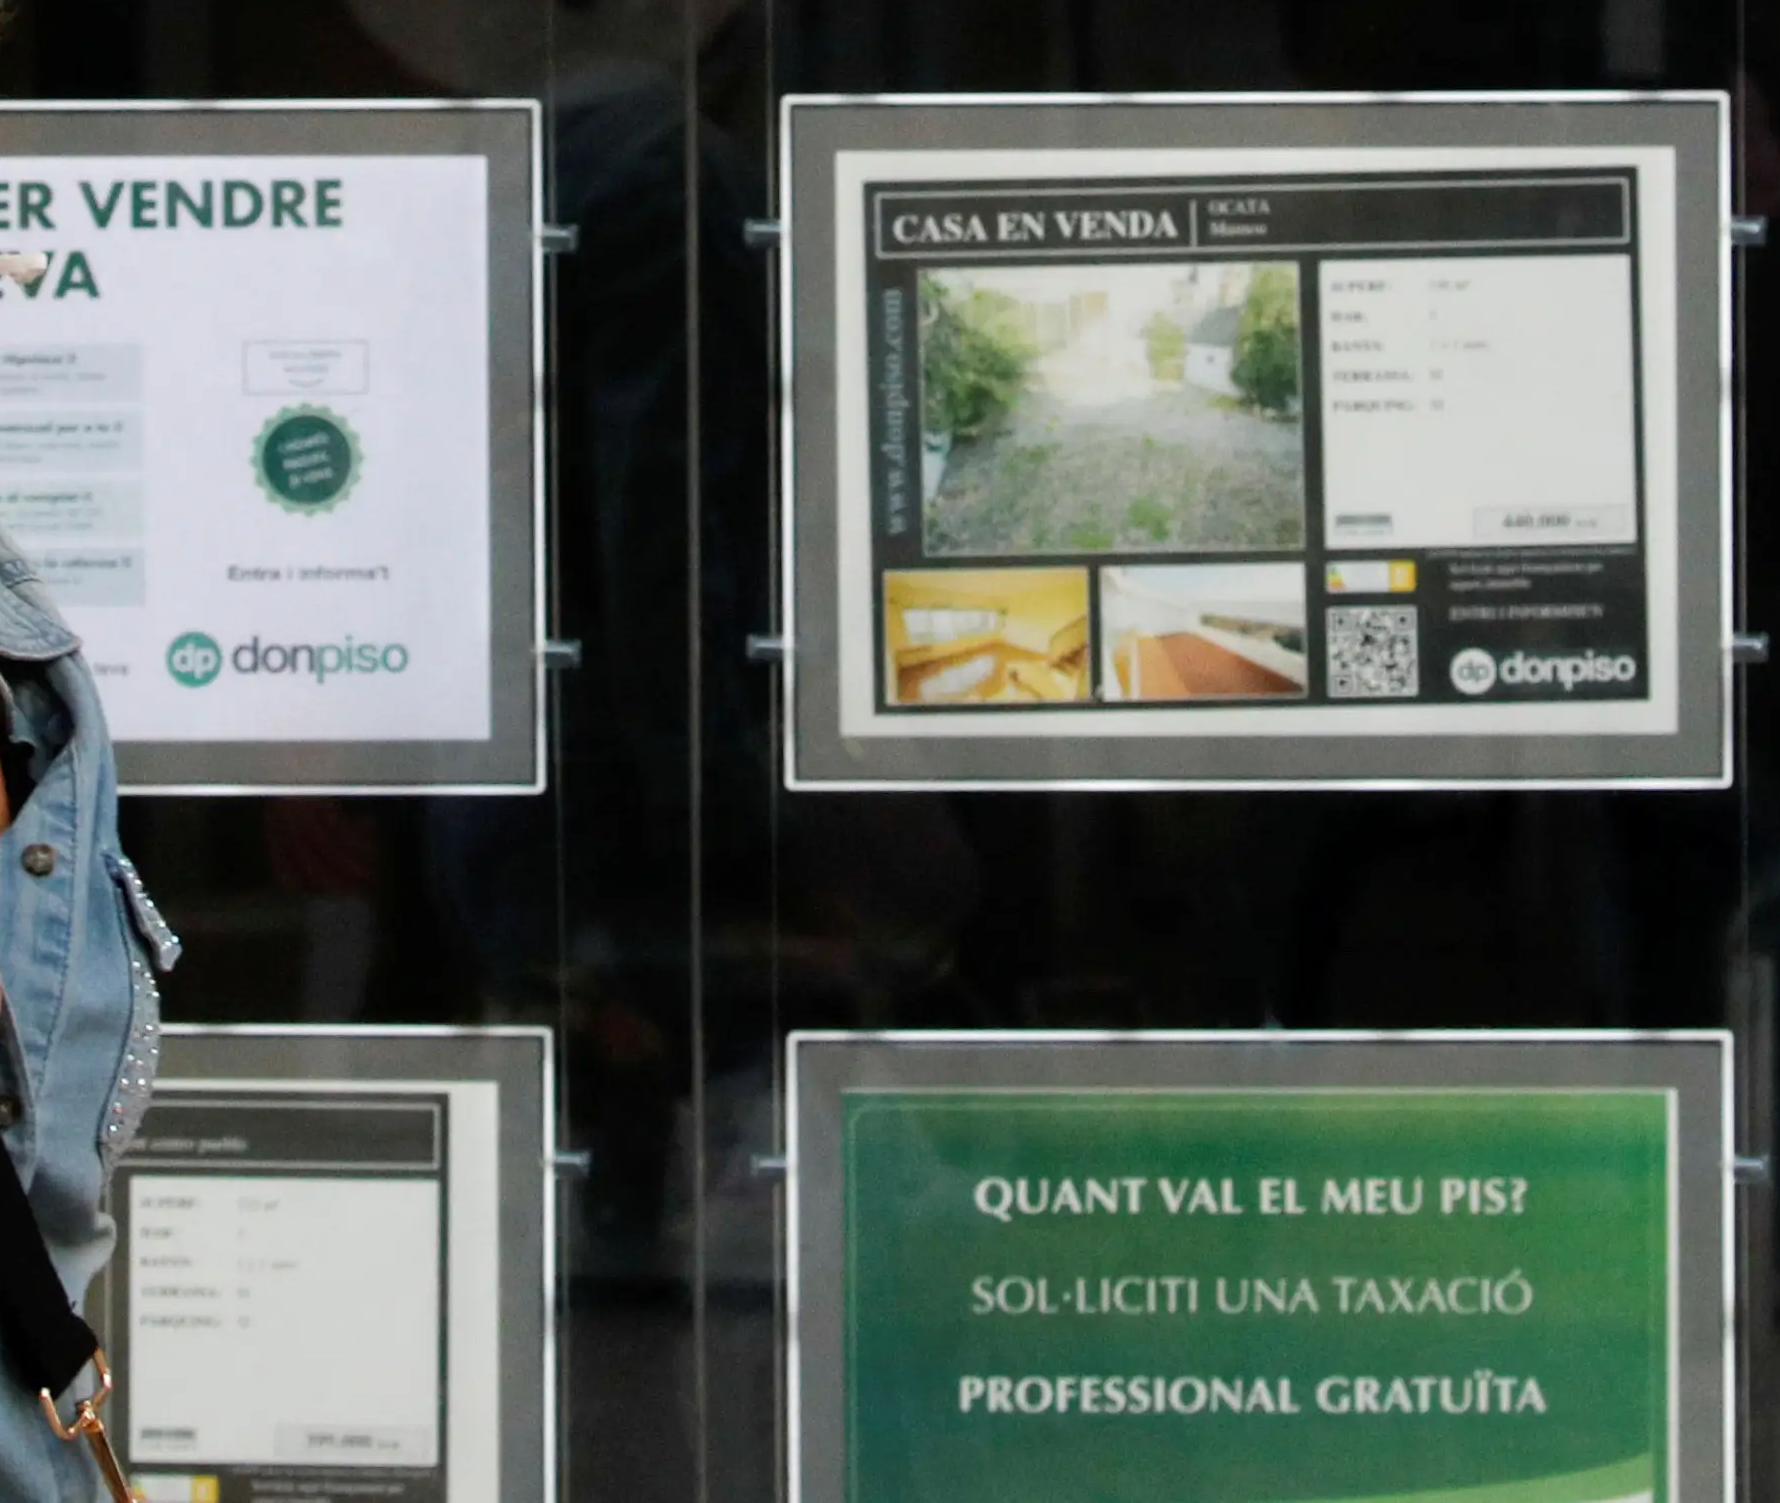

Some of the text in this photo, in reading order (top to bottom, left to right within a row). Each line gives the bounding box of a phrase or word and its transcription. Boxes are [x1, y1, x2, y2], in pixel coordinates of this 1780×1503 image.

[78, 178, 342, 230] VENDRE
[892, 209, 1179, 243] CASA EN VENDA
[880, 288, 910, 534] www.donpiso.com
[231, 635, 409, 684] donpiso
[1498, 649, 1637, 691] donpiso
[973, 1177, 1528, 1222] QUANT VAL EL MEU PIS?
[972, 1267, 1534, 1315] SOL·LICITI UNA TAXACIÓ
[959, 1369, 1547, 1414] PROFESSIONAL GRATUÏTA
